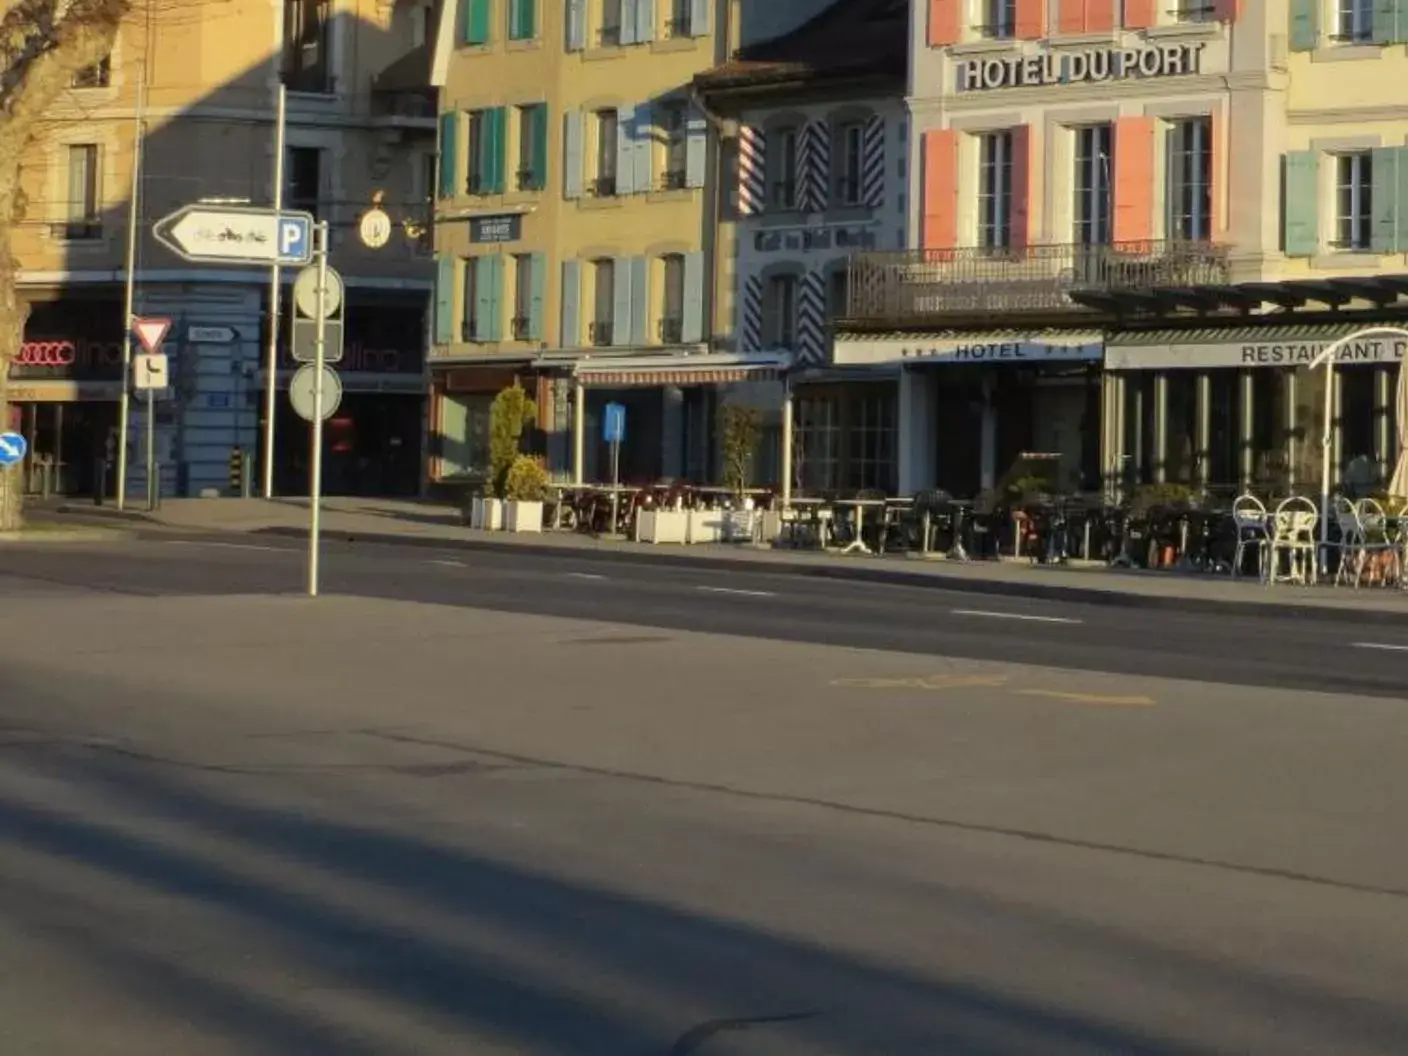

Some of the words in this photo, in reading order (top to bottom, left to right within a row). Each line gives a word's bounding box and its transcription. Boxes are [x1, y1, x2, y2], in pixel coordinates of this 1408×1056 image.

[964, 49, 1058, 89] HOTEL
[1068, 48, 1109, 81] DU
[1119, 42, 1204, 77] PORT
[281, 224, 301, 254] P
[955, 342, 1027, 360] HOTEL
